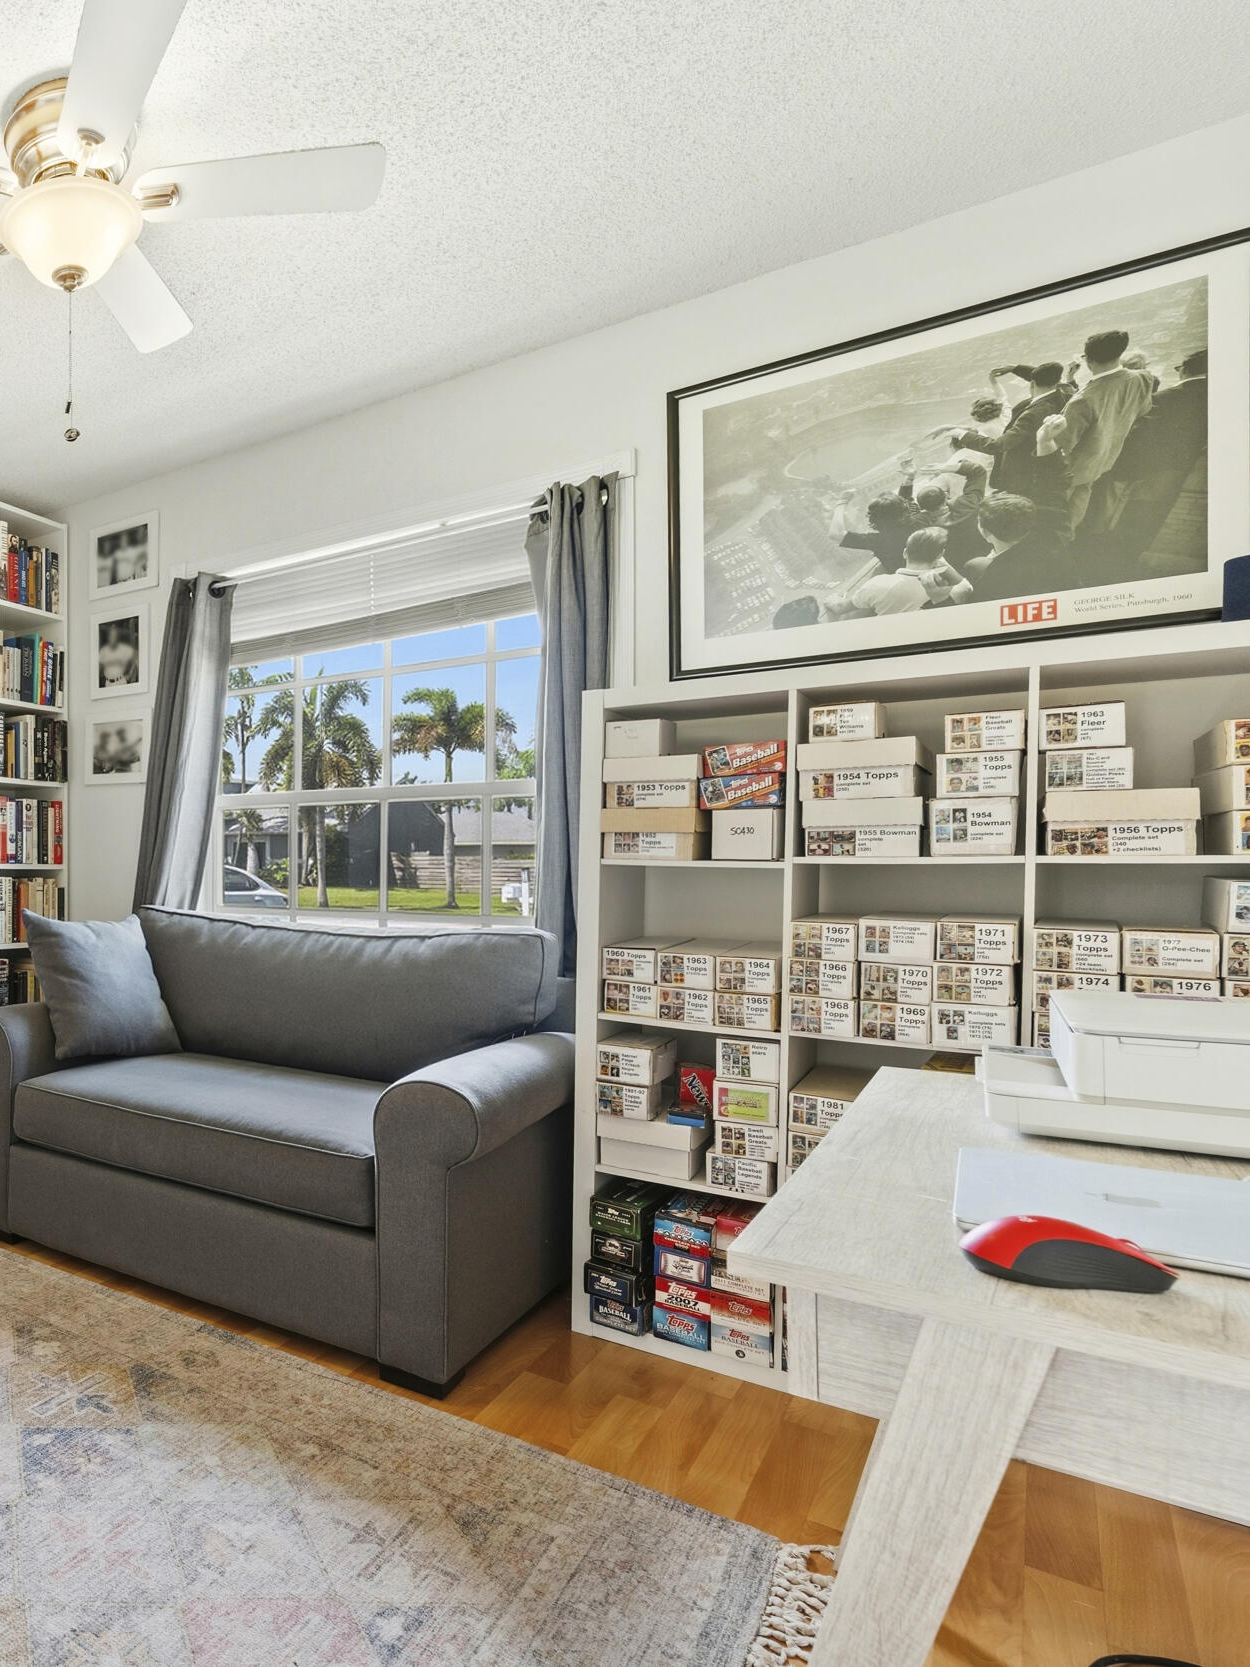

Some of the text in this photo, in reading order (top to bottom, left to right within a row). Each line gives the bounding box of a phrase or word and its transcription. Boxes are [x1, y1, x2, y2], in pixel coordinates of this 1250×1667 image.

[1074, 592, 1135, 606] GEORGE SILK
[1074, 604, 1097, 613] World
[1173, 593, 1193, 601] 1960
[1002, 601, 1055, 625] LIFE
[1081, 710, 1105, 718] 1963
[1080, 719, 1107, 727] Fleer
[732, 743, 779, 768] Baseball
[982, 763, 1013, 772] Topps
[836, 770, 900, 782] 1954 Topps
[636, 784, 686, 792] 1953 Topps
[726, 775, 774, 800] Baseball
[730, 827, 755, 836] SC430
[1112, 825, 1184, 835] 1956 Topps
[1112, 834, 1146, 842] Complete
[825, 926, 850, 935] 1967
[978, 928, 1006, 937] 1971
[824, 936, 850, 944] Topps
[976, 938, 1007, 946] Topps
[1076, 934, 1109, 944] 1973
[1076, 944, 1109, 954] Topps
[606, 950, 647, 960] 1960 Topps
[686, 956, 708, 964] 1963
[748, 960, 770, 968] 1964
[822, 963, 848, 972] 1966
[974, 968, 1003, 976] 1972
[821, 972, 847, 980] Topps
[901, 968, 928, 978] 1970
[900, 978, 928, 987] Topps
[973, 977, 1003, 986] Topps
[1078, 976, 1110, 986] 1974
[632, 985, 652, 993] 1961
[1176, 981, 1212, 992] 1976
[686, 992, 708, 1000] 1962
[686, 1001, 708, 1009] Topps
[746, 997, 768, 1005] 1965
[824, 1001, 850, 1010] 1968
[823, 1010, 850, 1018] Topps
[899, 1006, 926, 1016] 1969
[898, 1016, 926, 1026] Topps
[820, 1100, 844, 1110] 1981
[738, 1166, 763, 1174] Baseball
[738, 1172, 762, 1180] Legends
[668, 1282, 699, 1299] Topps
[666, 1294, 699, 1307] 2007
[728, 1301, 752, 1316] Topps
[598, 1306, 632, 1322] BASEBALL
[667, 1314, 697, 1332] Topps
[656, 1322, 705, 1341] BASEBALL
[729, 1328, 750, 1341] Topps
